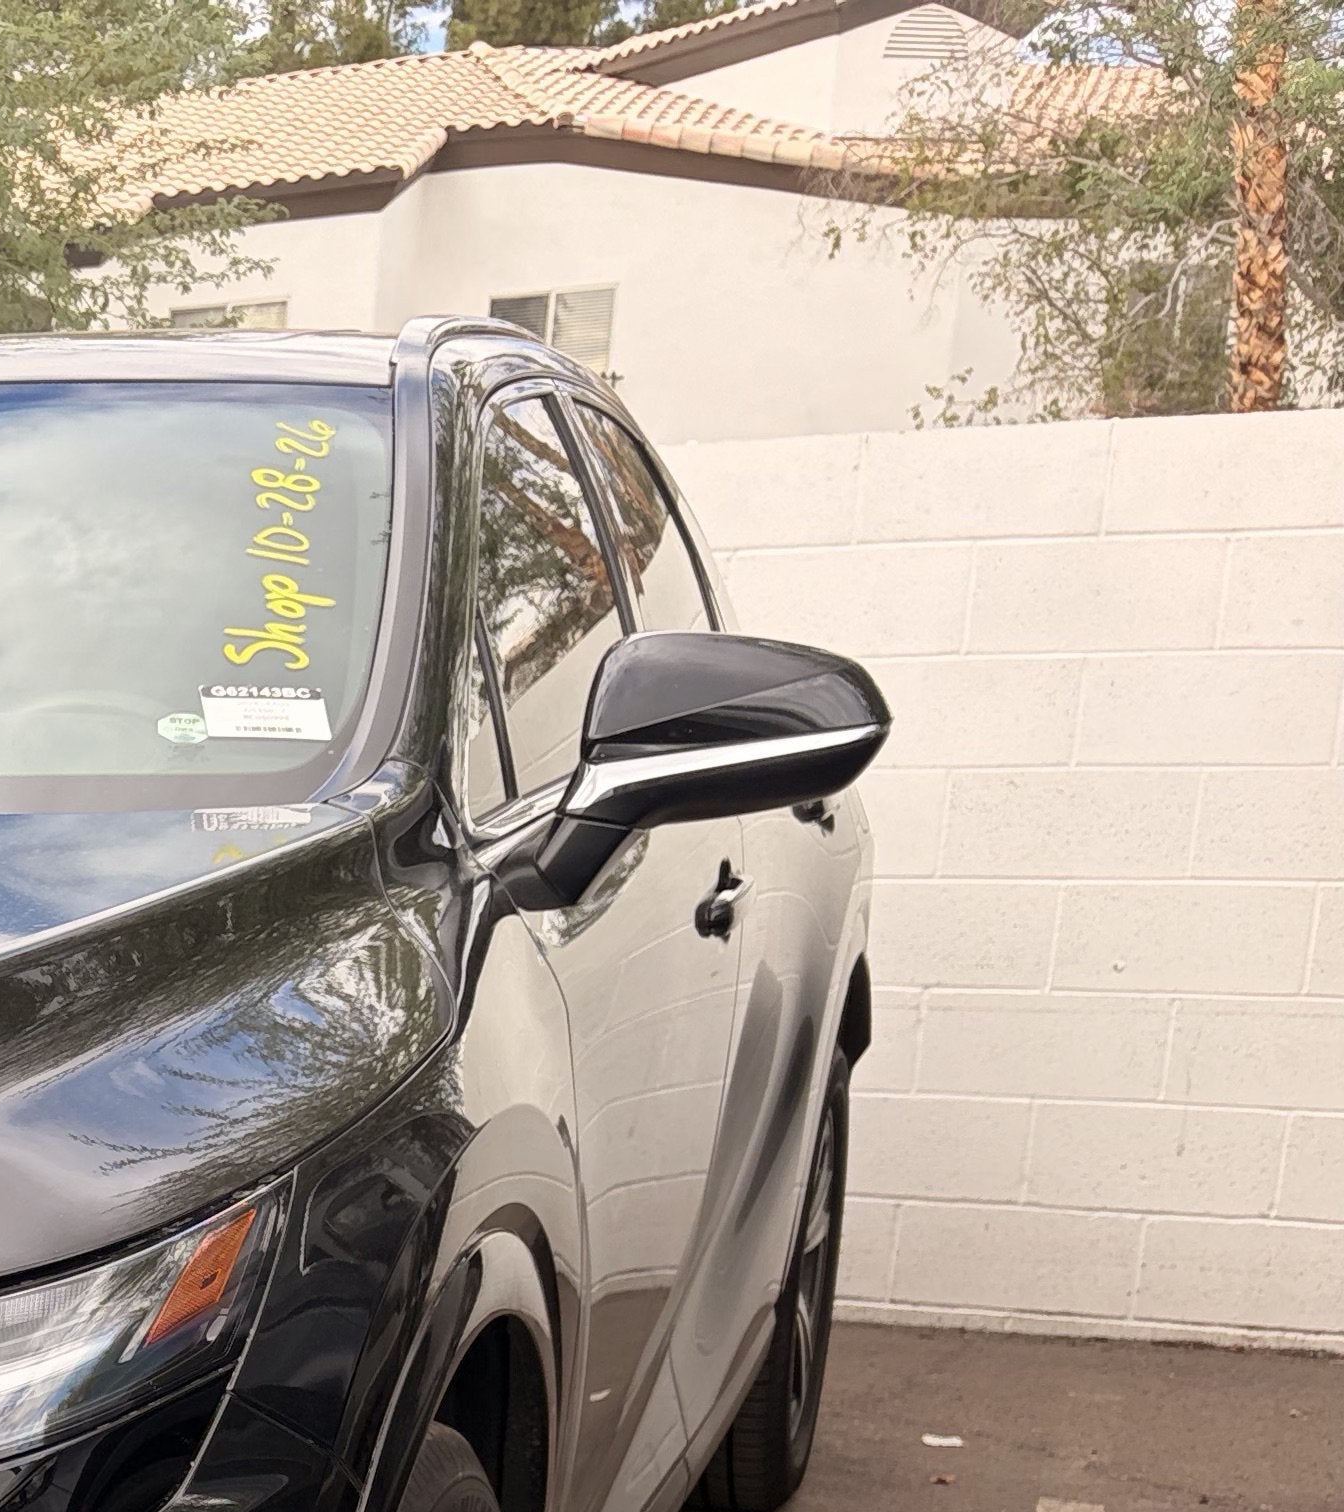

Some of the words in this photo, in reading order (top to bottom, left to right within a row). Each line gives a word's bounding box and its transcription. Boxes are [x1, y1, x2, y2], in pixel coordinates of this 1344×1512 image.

[245, 419, 337, 565] 10-28-26
[223, 573, 336, 670] Shop
[169, 717, 201, 725] STOP
